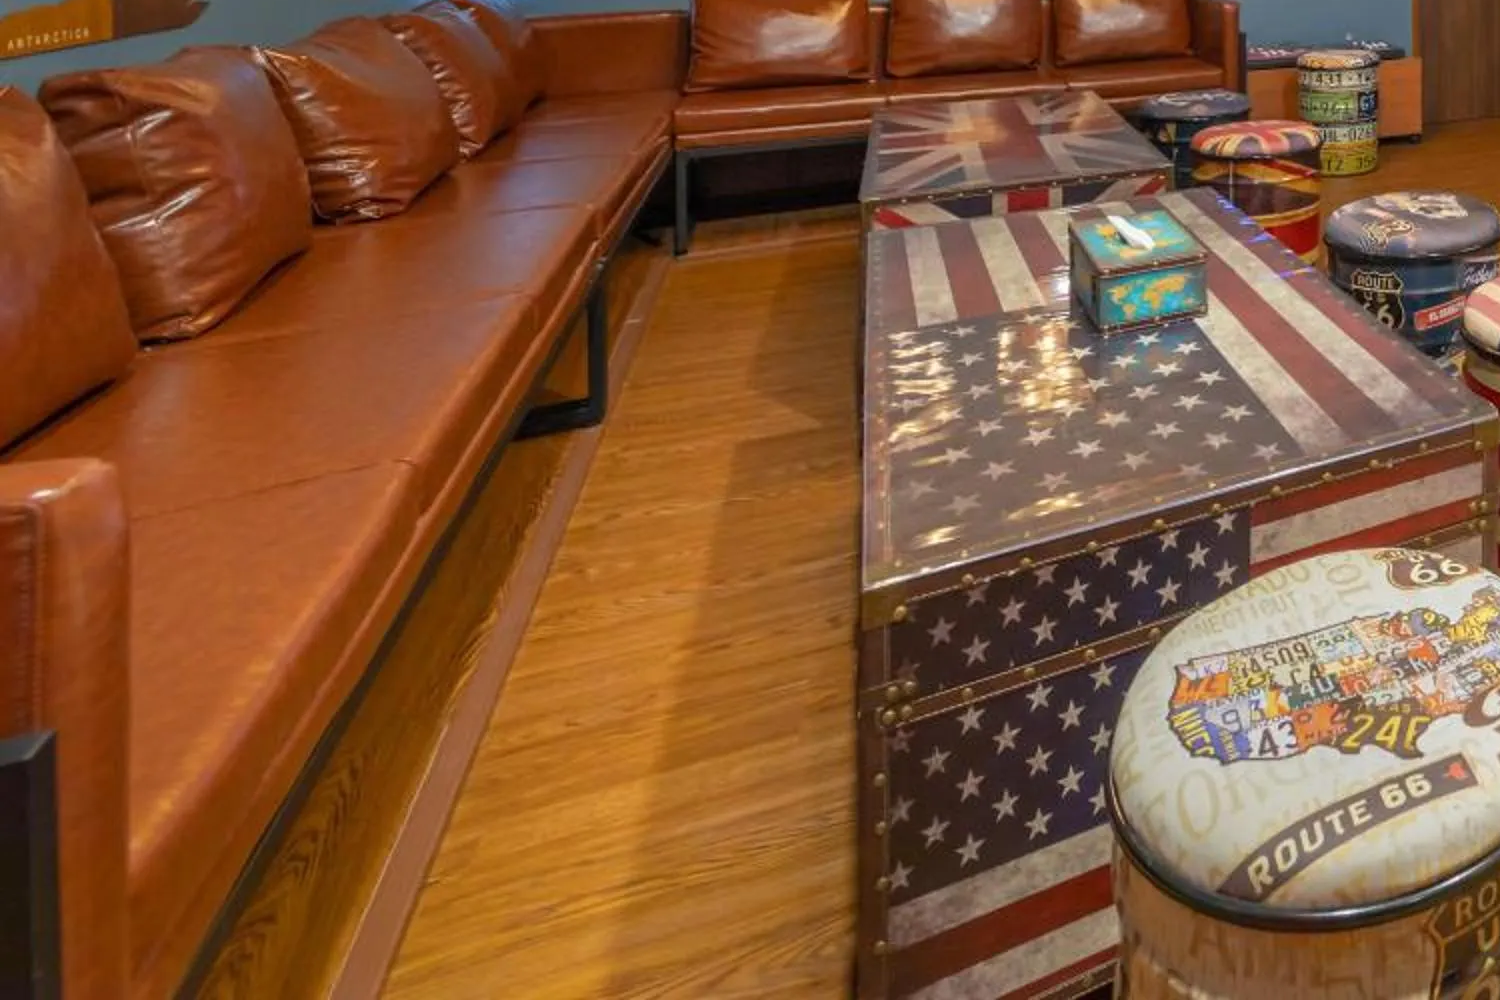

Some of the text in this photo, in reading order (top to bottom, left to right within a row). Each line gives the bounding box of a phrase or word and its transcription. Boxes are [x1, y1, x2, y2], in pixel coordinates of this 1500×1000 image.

[7, 27, 91, 51] ANTARCTICA
[1356, 275, 1394, 288] ROUTE
[1410, 559, 1469, 583] 66
[1247, 802, 1372, 894] ROUTE
[1379, 773, 1433, 810] 66
